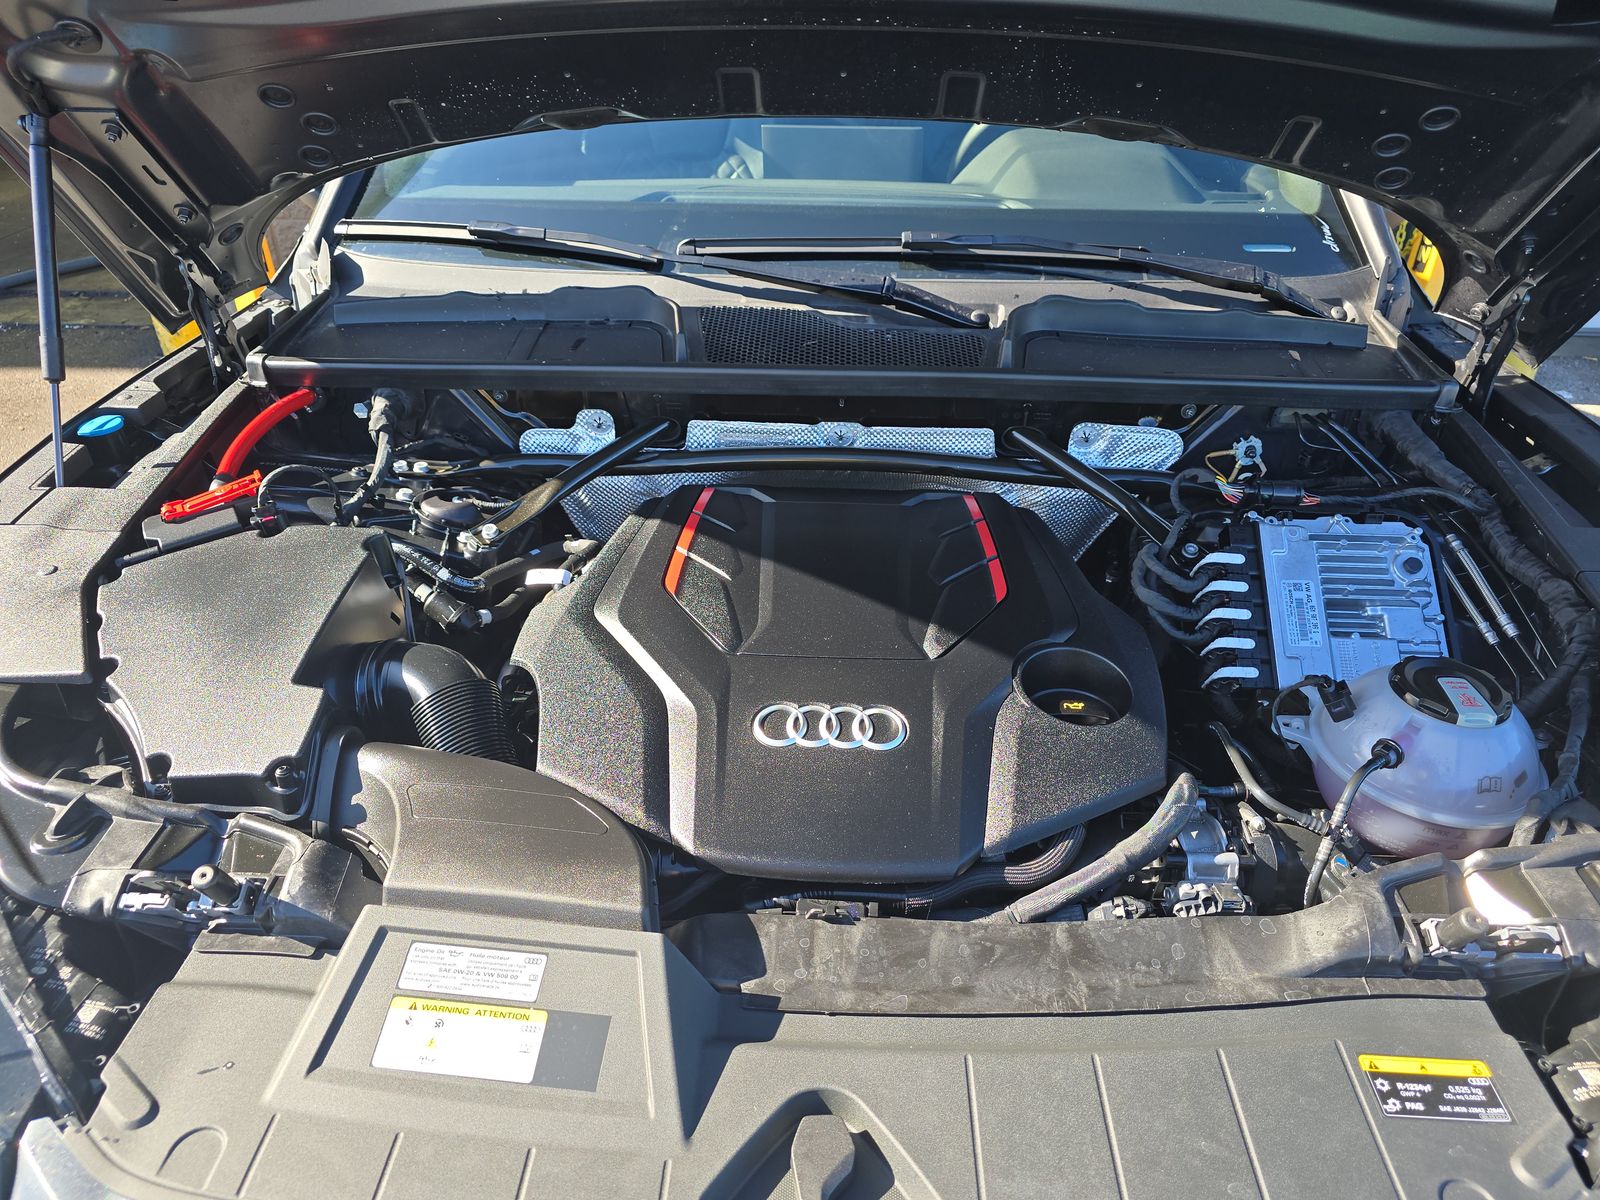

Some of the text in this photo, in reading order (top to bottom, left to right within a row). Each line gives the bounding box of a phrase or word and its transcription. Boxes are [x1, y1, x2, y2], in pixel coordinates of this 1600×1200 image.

[414, 947, 435, 955] Engine
[421, 1004, 531, 1021] WARNING ATTENTION
[1471, 1086, 1483, 1096] kg
[1404, 1101, 1425, 1111] PAG
